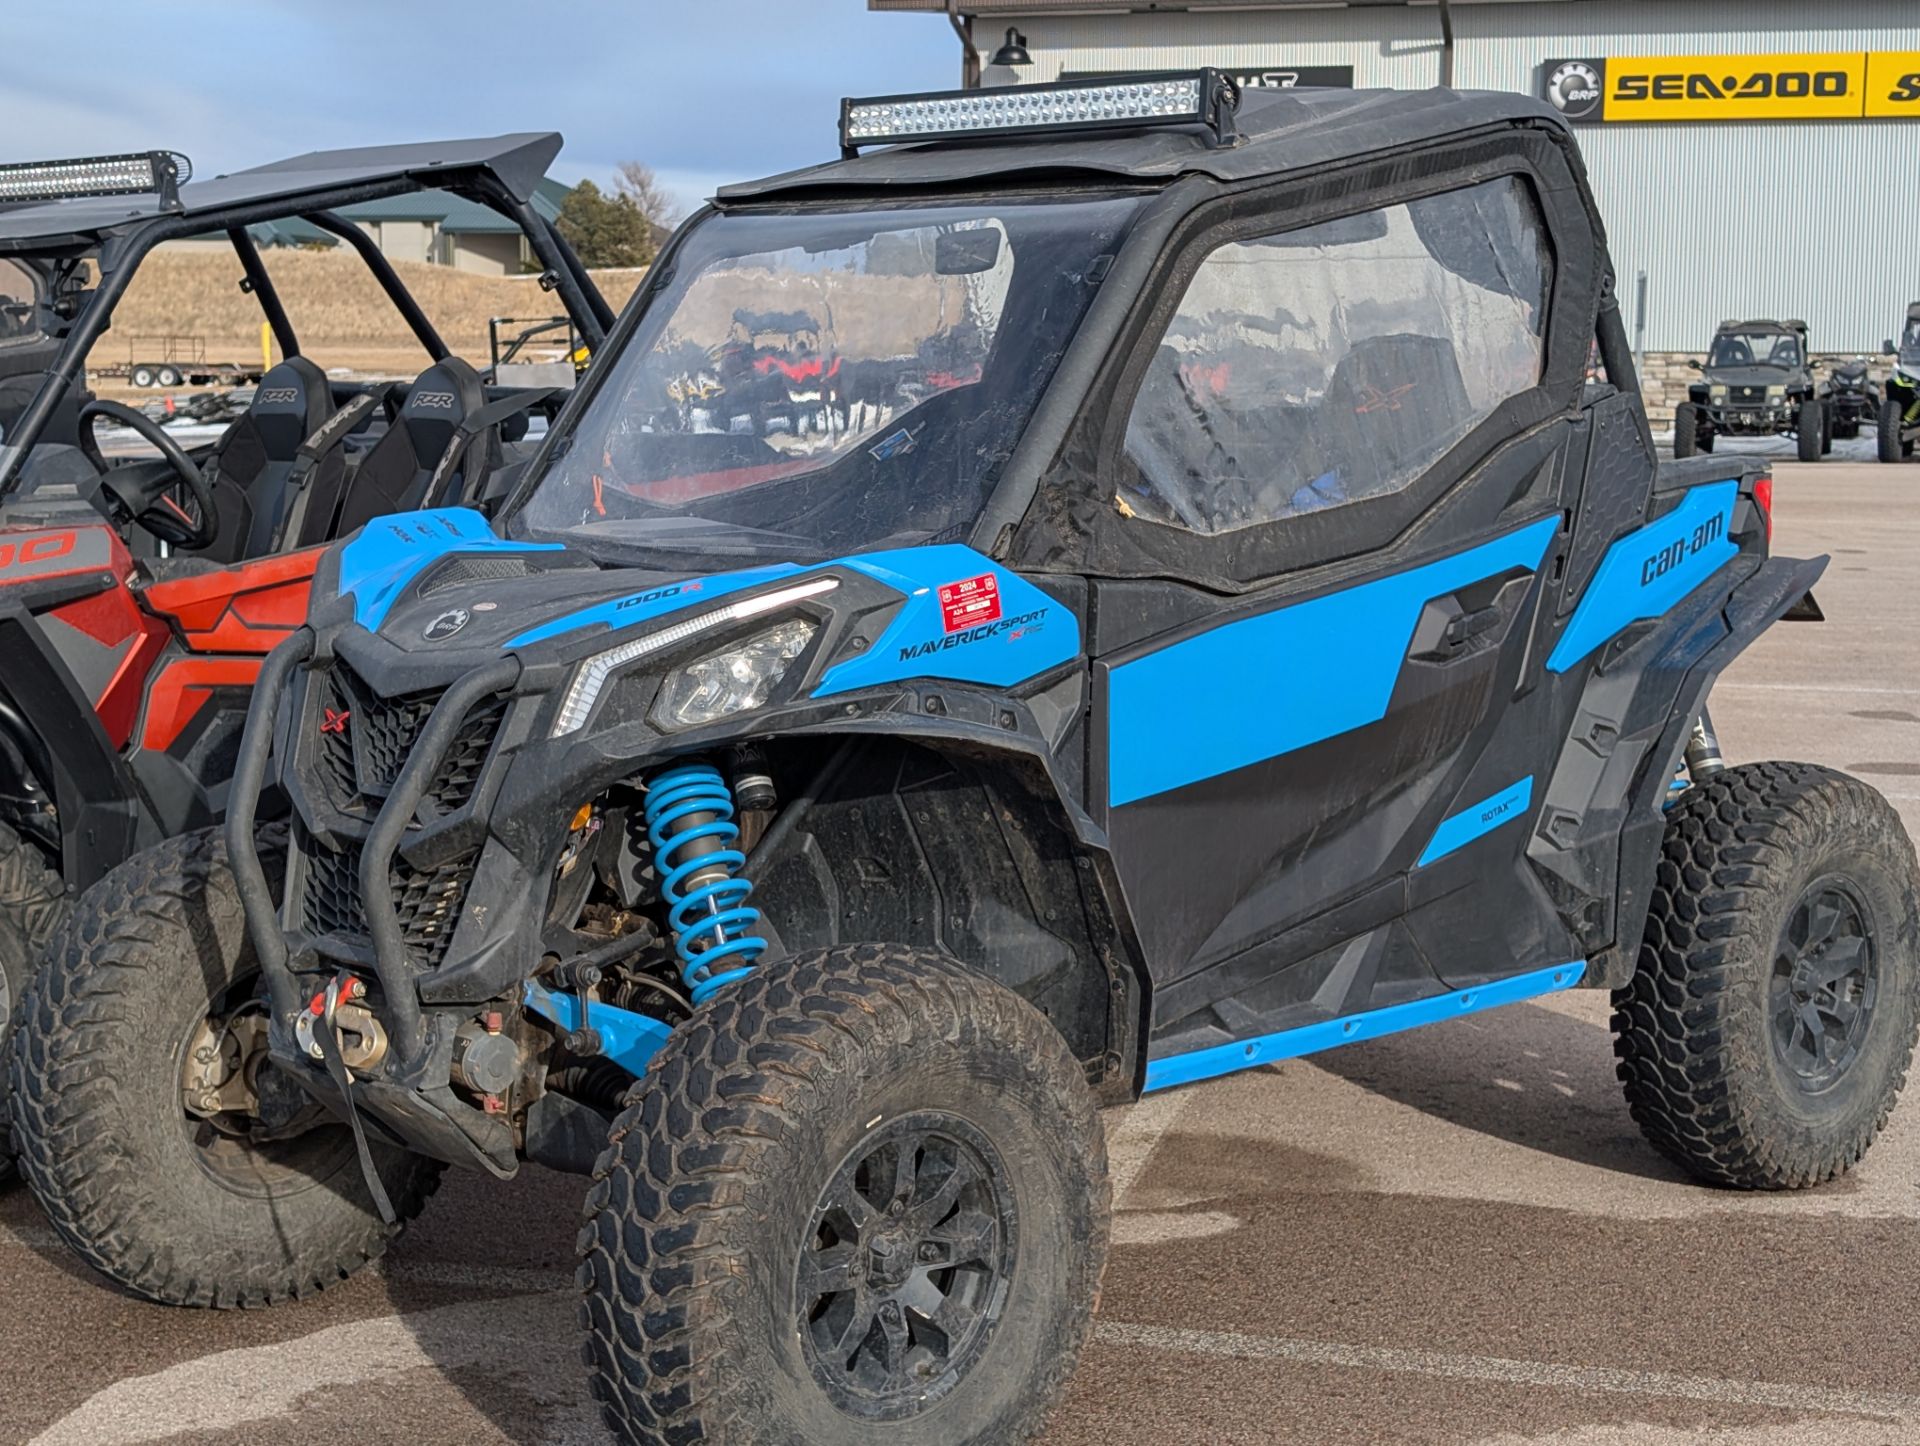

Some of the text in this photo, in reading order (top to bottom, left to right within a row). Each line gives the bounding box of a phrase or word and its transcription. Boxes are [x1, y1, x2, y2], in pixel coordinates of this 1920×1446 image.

[1568, 89, 1600, 101] BRP
[259, 388, 298, 404] RZR
[412, 391, 454, 408] RZR
[1641, 511, 1723, 587] can-am
[959, 580, 977, 592] 2024
[616, 583, 704, 611] 1000R
[437, 622, 458, 630] BRP
[899, 622, 1000, 662] MAVERICK
[1000, 608, 1048, 631] SPORT
[1481, 801, 1509, 823] ROTAX
